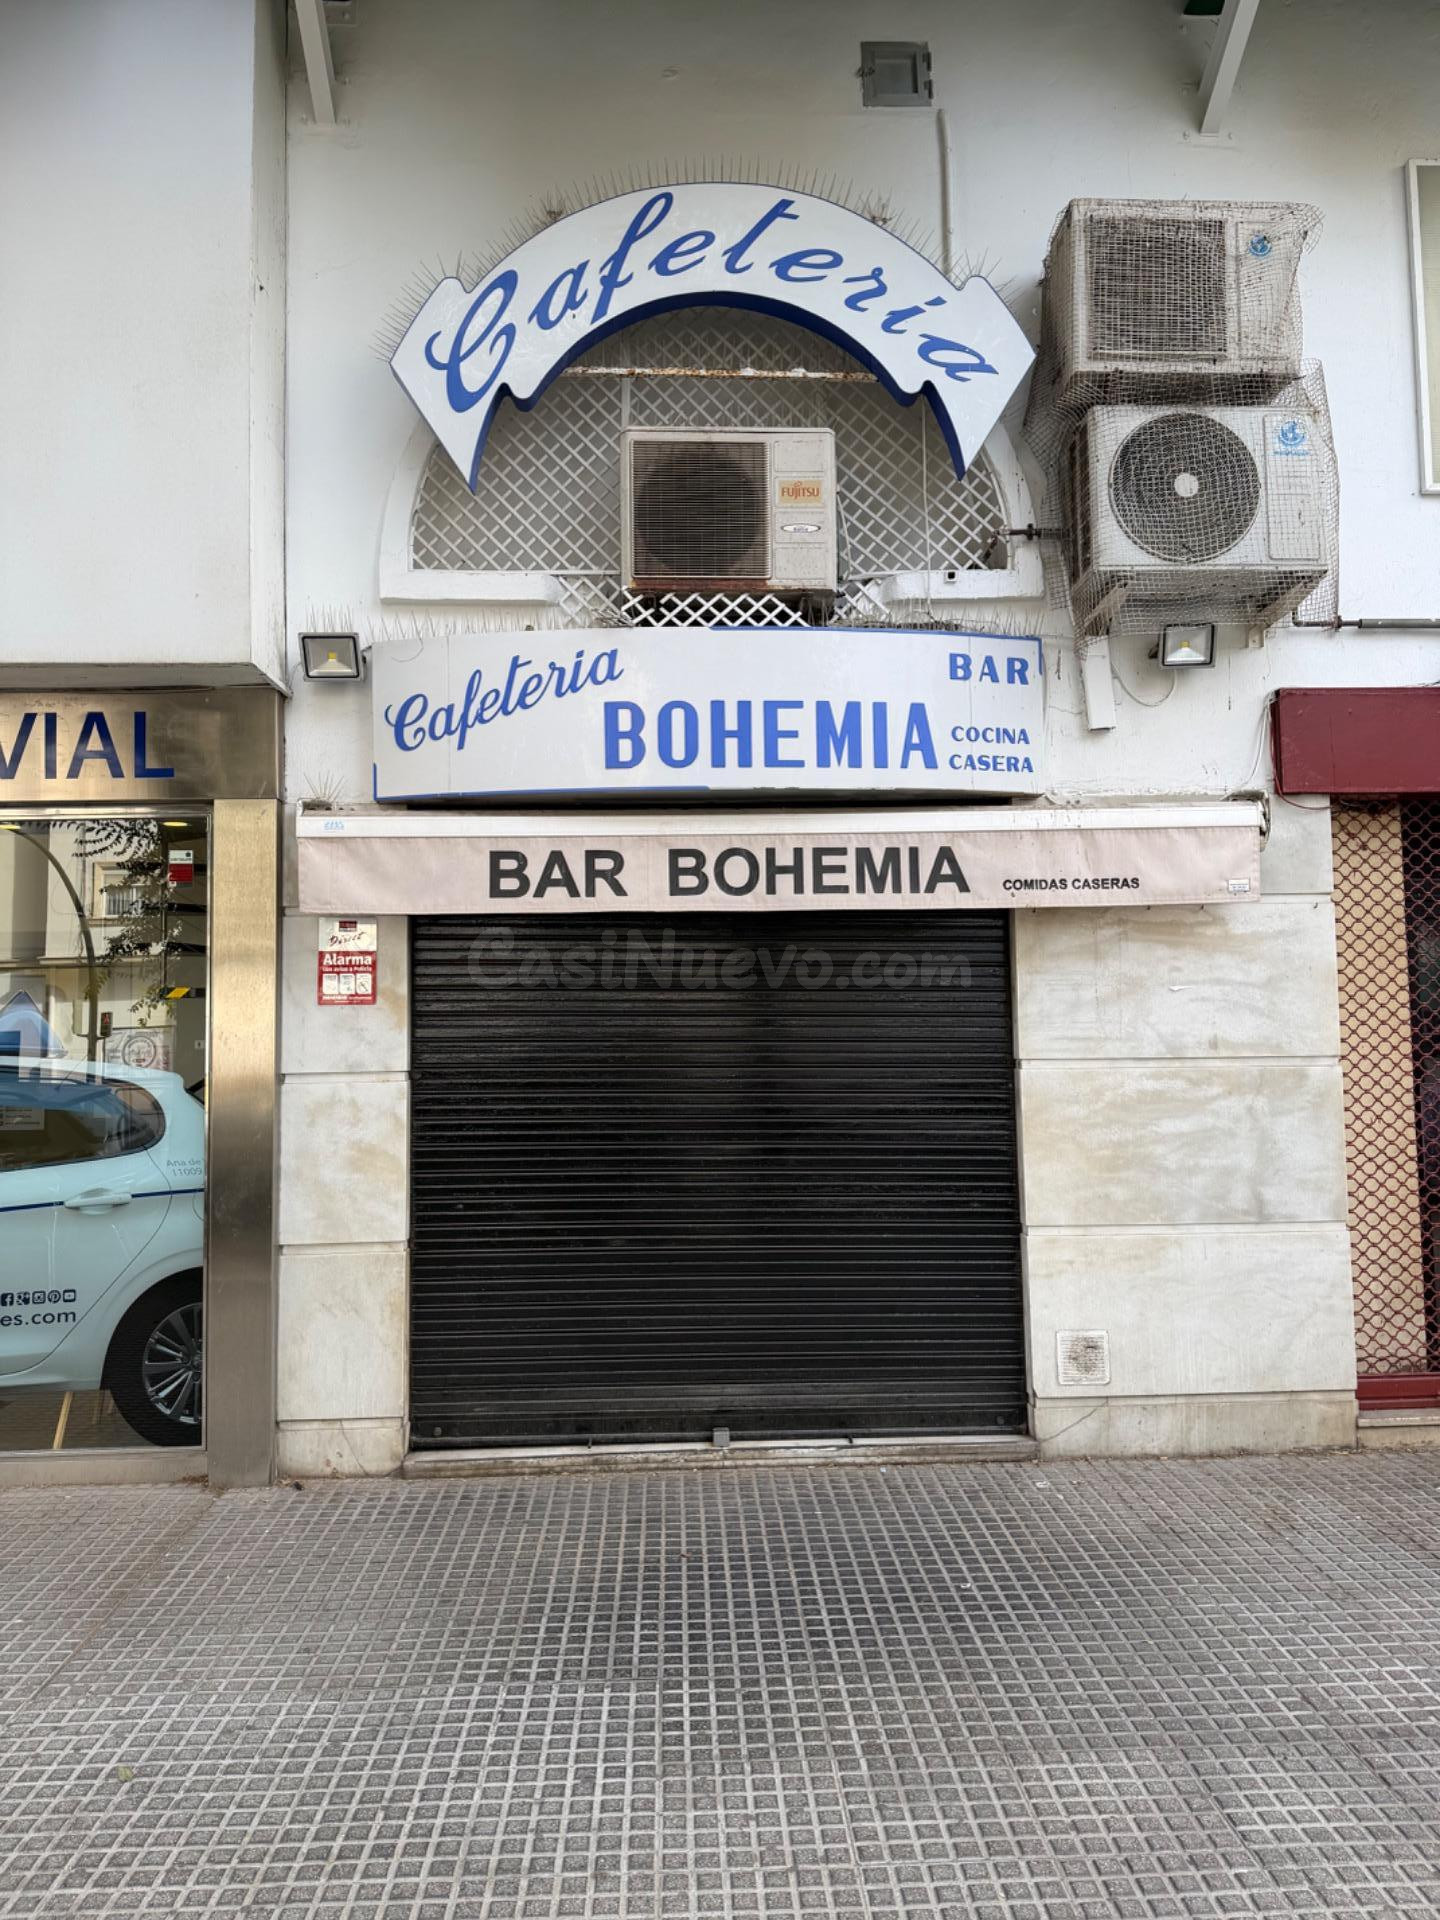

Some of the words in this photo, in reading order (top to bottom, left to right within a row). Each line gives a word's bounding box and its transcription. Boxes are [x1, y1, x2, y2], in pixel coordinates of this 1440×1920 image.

[424, 191, 999, 413] Cafeteria
[781, 479, 820, 499] FUJITSU
[949, 653, 1030, 685] BAR
[385, 648, 624, 751] Cafeteria
[603, 700, 938, 769] BOHEMIA
[951, 725, 1030, 745] COCINA
[948, 754, 1034, 773] CASERA
[488, 850, 628, 899] BAR
[667, 846, 971, 896] BOHEMIA
[1002, 879, 1068, 890] COMIDAS
[1071, 878, 1140, 889] CASERAS
[323, 953, 372, 965] Alarma
[0, 1311, 76, 1326] es.com
